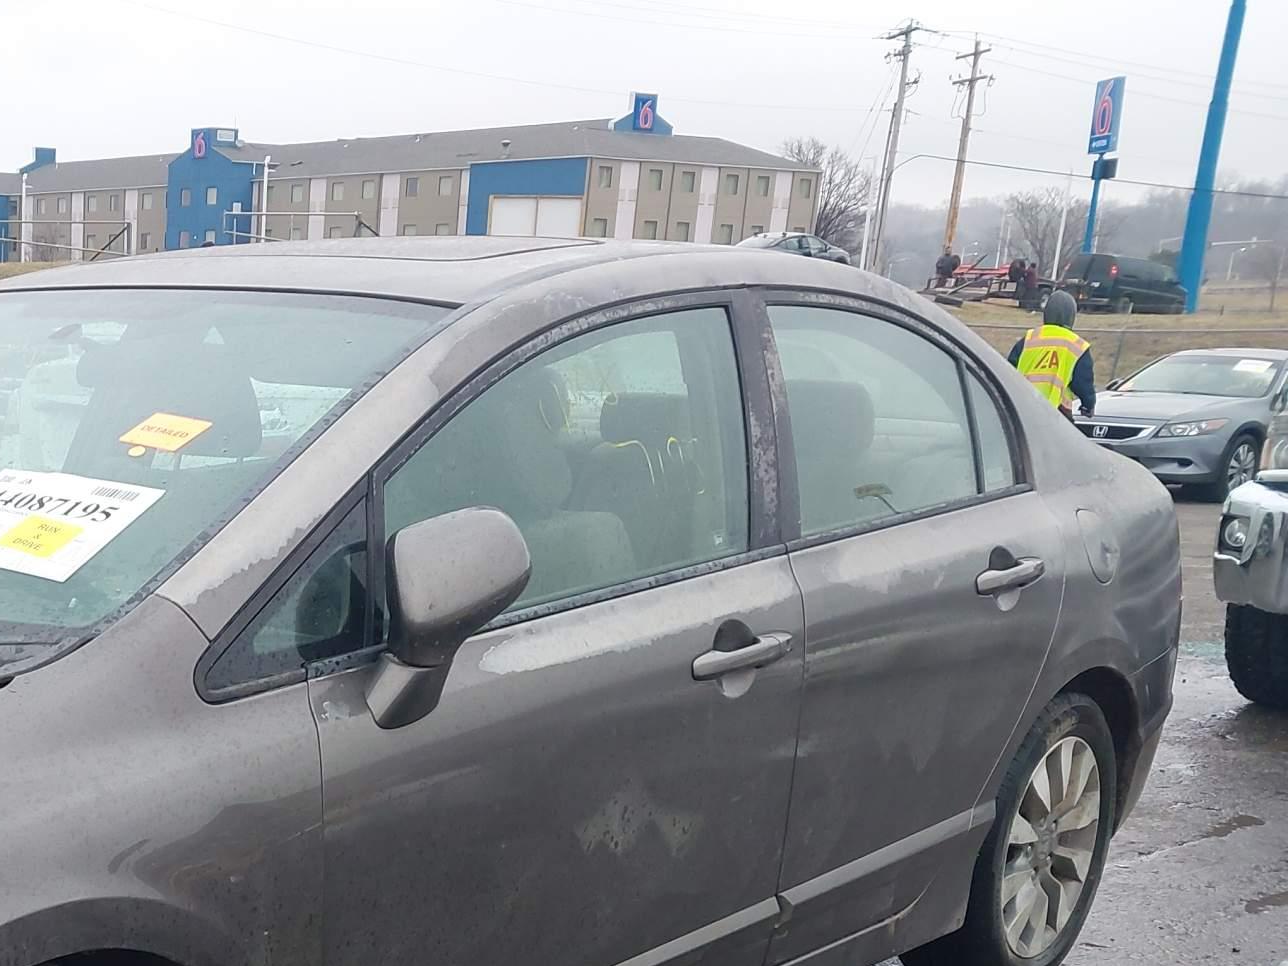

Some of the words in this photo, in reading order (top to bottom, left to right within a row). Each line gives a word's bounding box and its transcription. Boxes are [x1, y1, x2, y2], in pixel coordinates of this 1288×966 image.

[639, 99, 653, 129] 6
[1096, 79, 1114, 136] 6
[194, 131, 206, 160] 6
[37, 523, 61, 534] RUN
[12, 537, 44, 551] DRIVE
